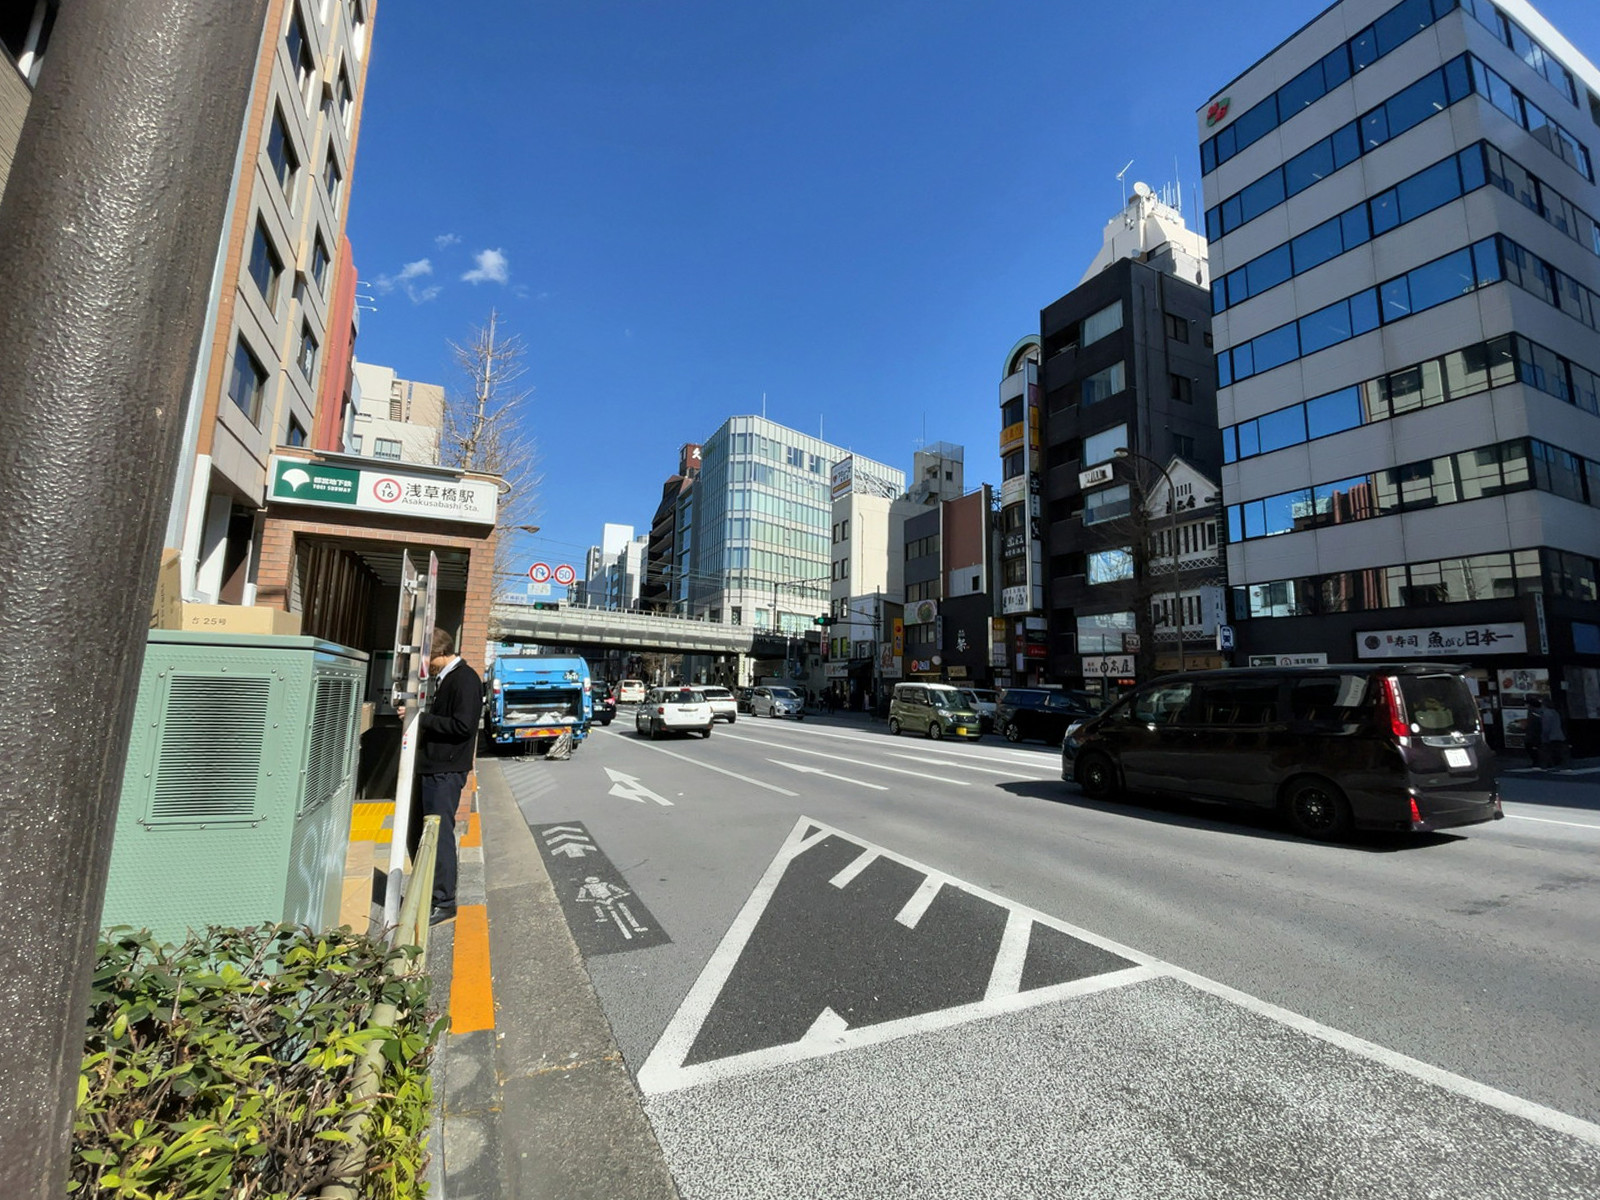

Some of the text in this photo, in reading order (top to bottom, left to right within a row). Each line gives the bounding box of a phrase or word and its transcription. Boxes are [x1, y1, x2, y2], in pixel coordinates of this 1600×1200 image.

[313, 476, 352, 487] 都営地下鉄
[384, 482, 391, 490] A
[327, 485, 352, 493] SUBWAY
[382, 490, 394, 498] 16
[405, 482, 475, 504] 浅草橋駅
[401, 497, 480, 512] Asakusabashi Sta.
[558, 569, 571, 580] 50
[1394, 635, 1418, 648] 寿司
[1427, 629, 1514, 648] 魚がし日本一
